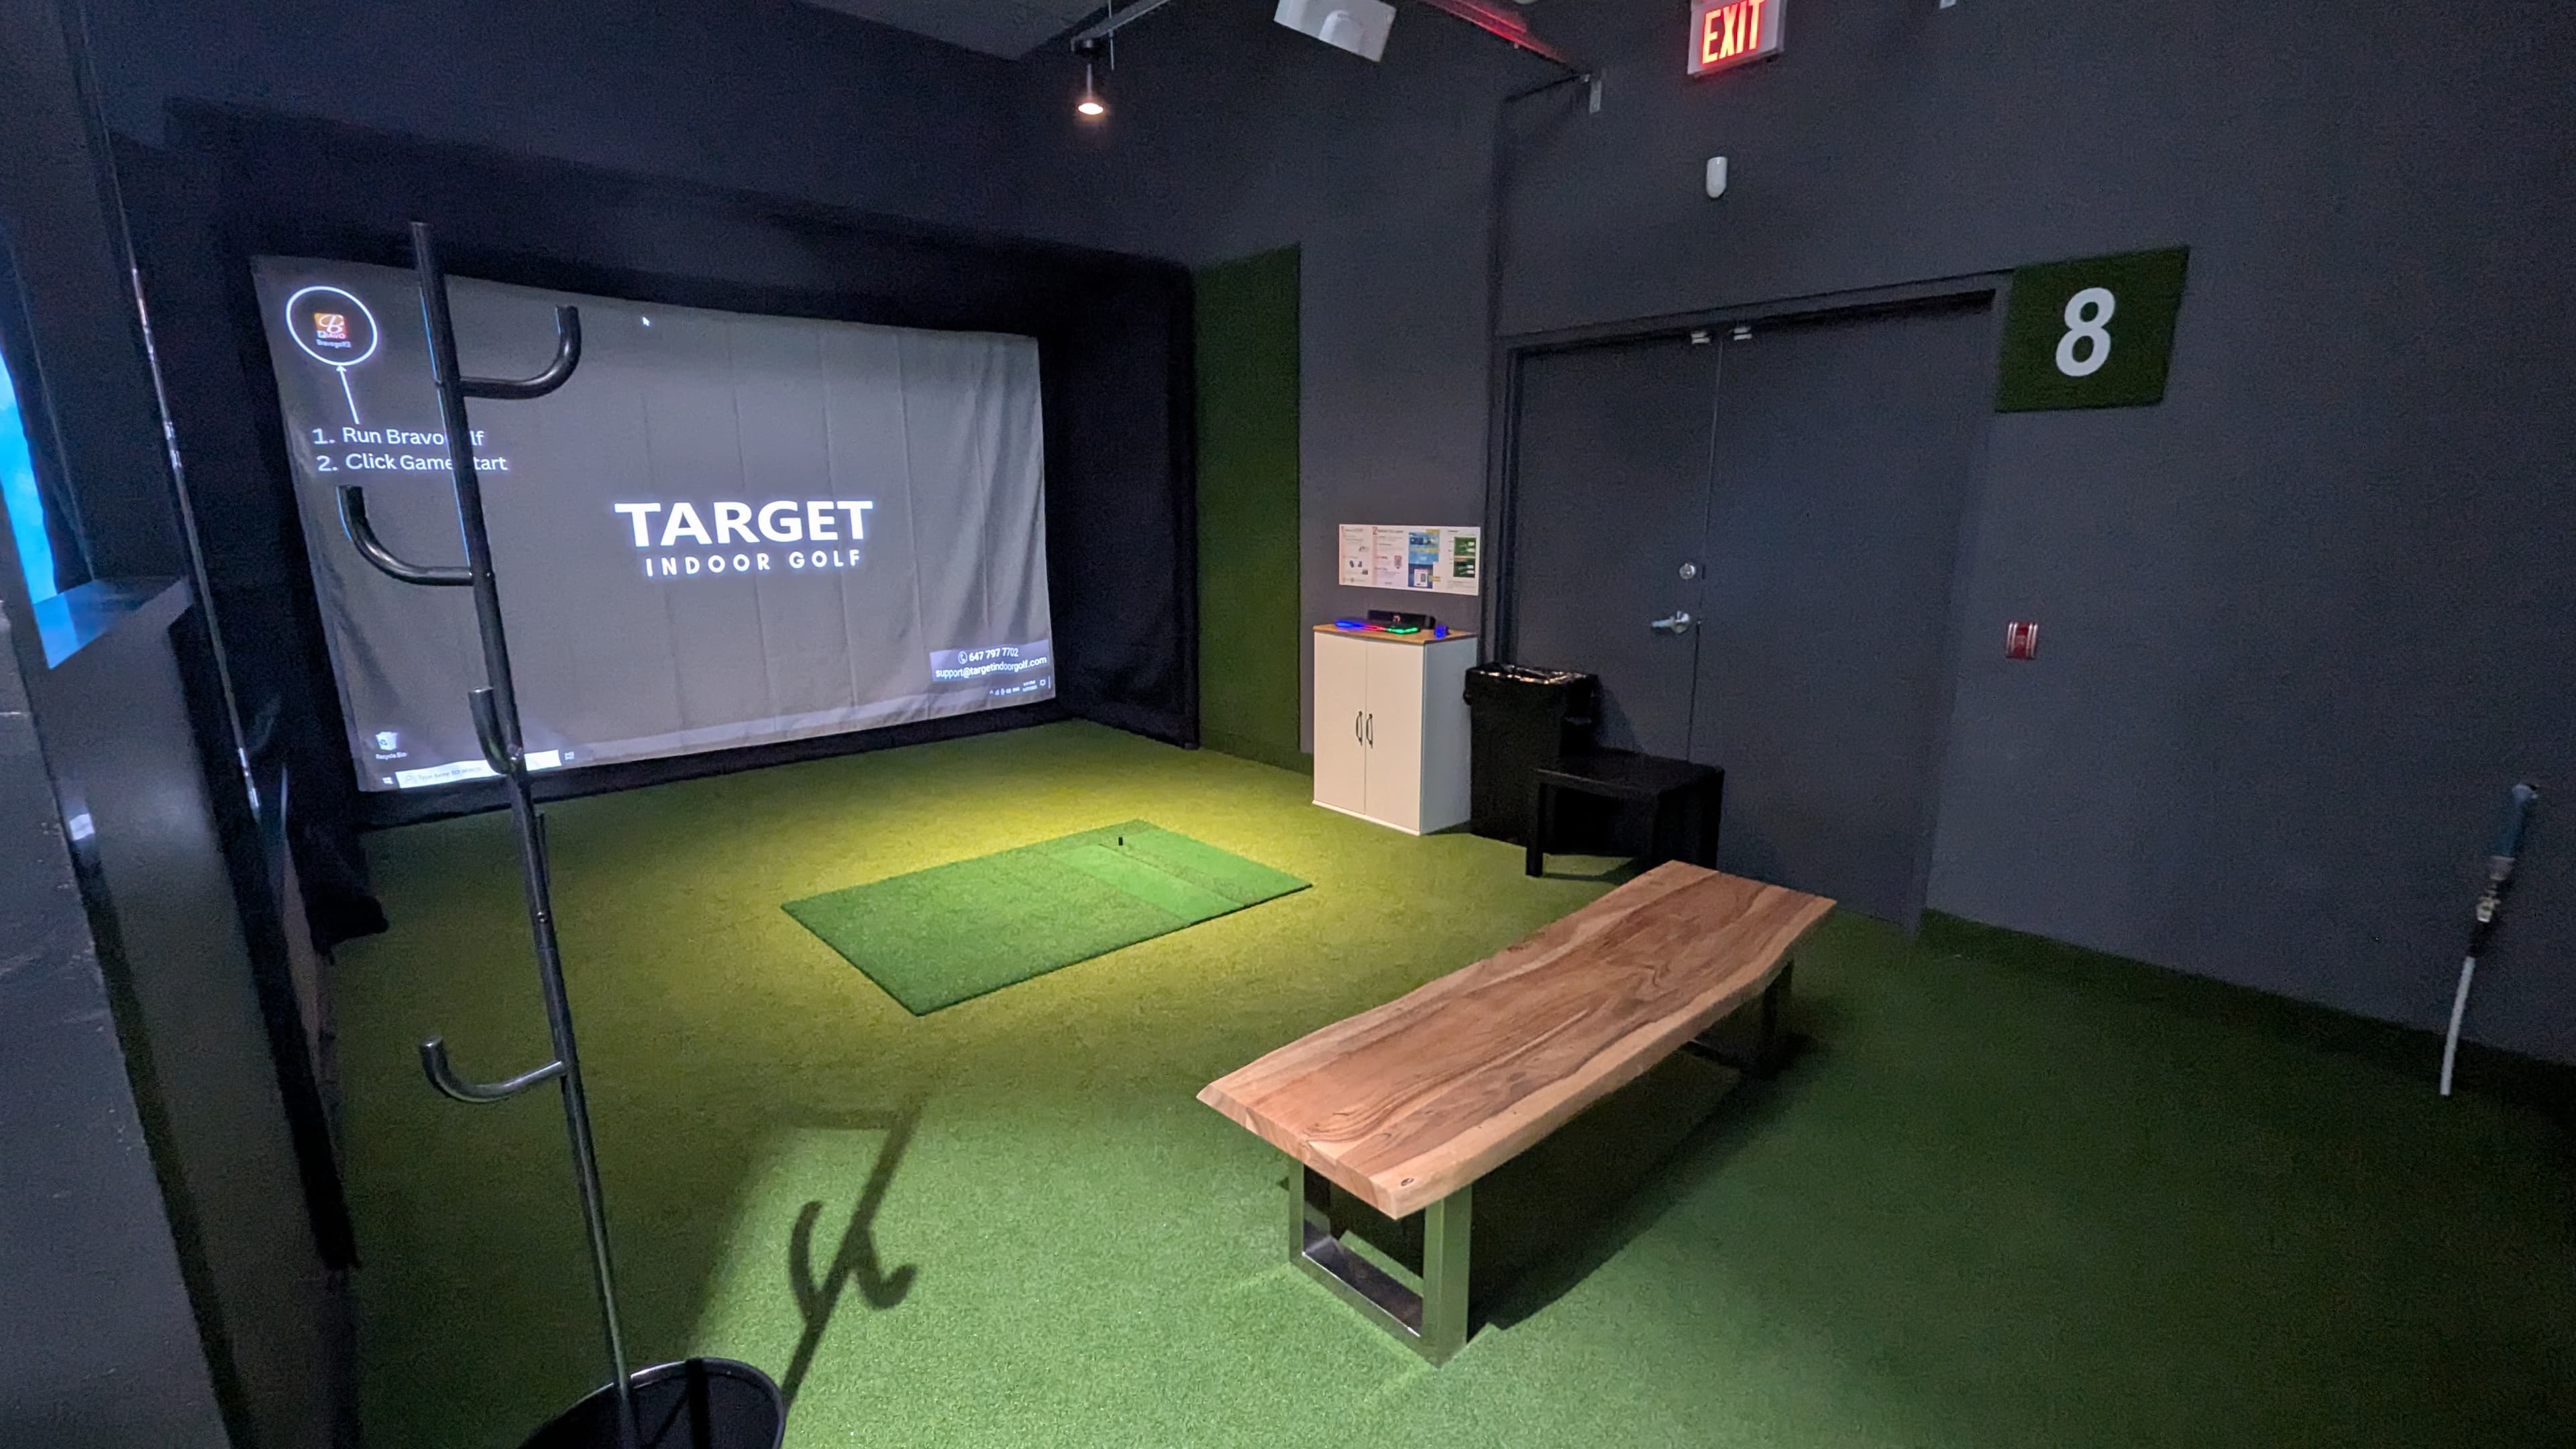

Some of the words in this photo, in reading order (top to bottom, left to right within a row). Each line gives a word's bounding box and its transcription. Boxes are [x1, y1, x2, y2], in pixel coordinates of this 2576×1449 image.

[1702, 0, 1766, 64] EXIT
[2055, 286, 2115, 377] 8
[312, 428, 335, 444] 1.
[342, 427, 382, 443] Run
[386, 429, 484, 445] Bravolf
[317, 455, 338, 471] 2.
[345, 453, 397, 470] Click
[472, 457, 509, 470] tart
[614, 500, 873, 547] TARGET
[646, 553, 771, 577] INDOOR
[789, 549, 861, 569] GOLF
[969, 651, 985, 662] 647
[985, 648, 1001, 659] 797
[1002, 647, 1019, 657] 7702
[935, 657, 1047, 678] support@targetindoorgolf.com
